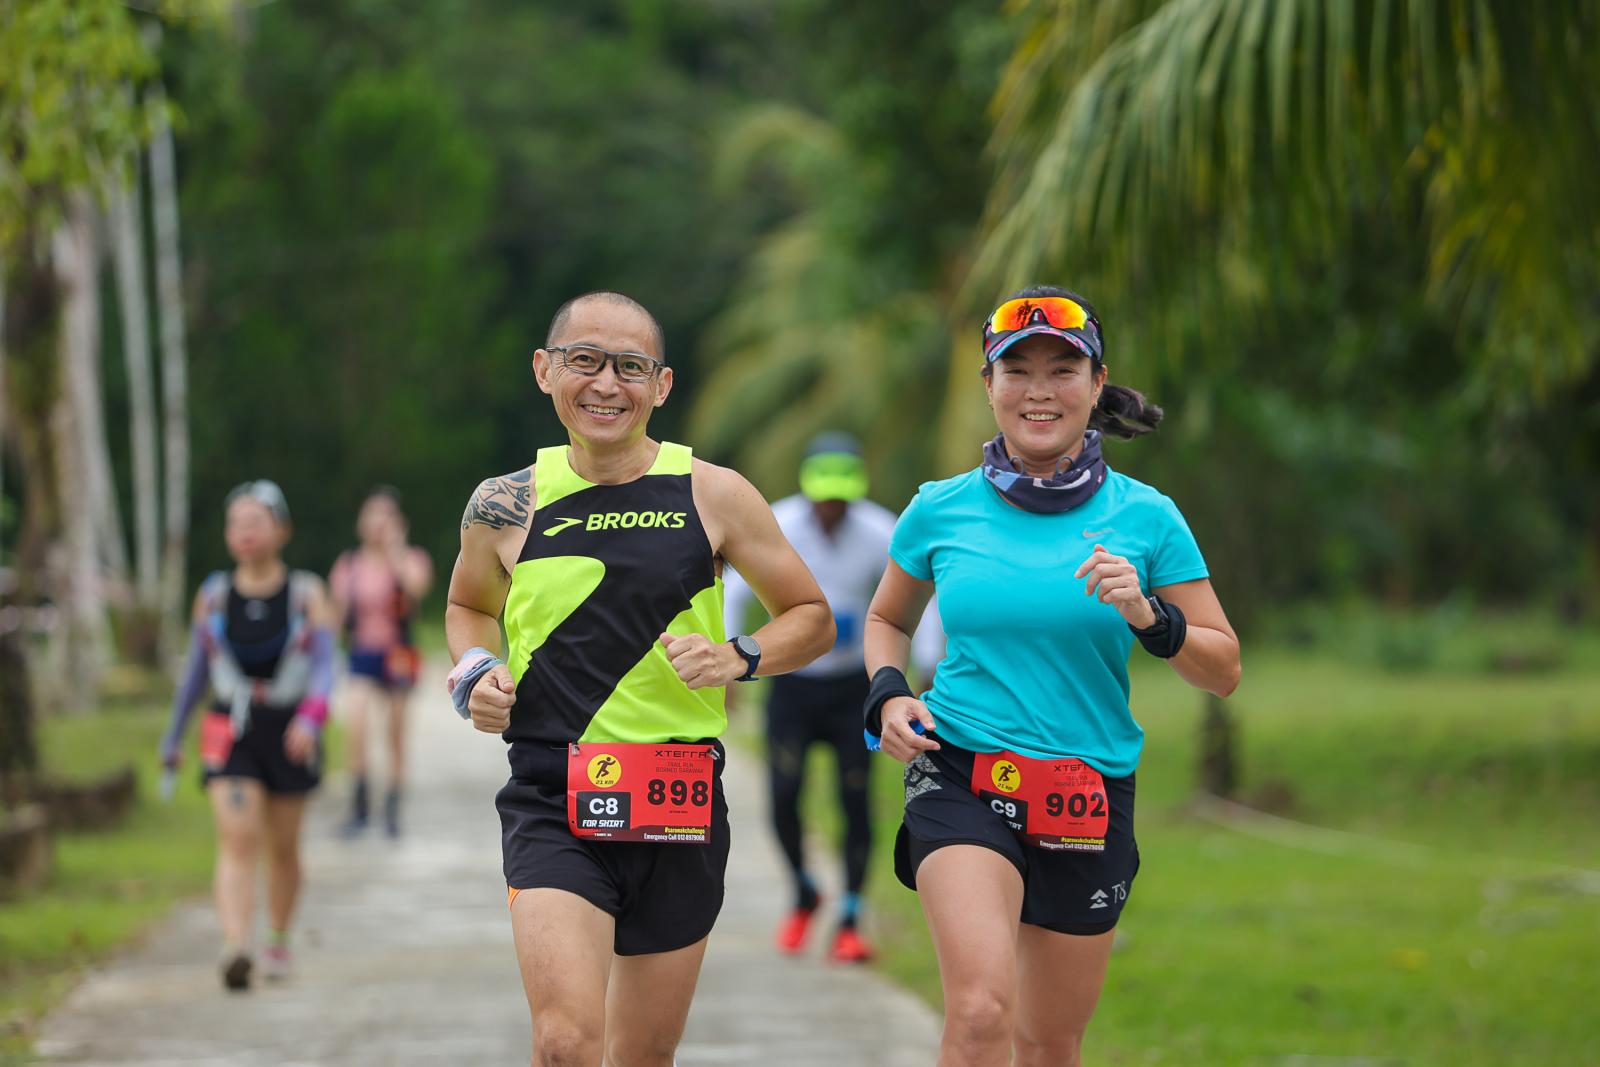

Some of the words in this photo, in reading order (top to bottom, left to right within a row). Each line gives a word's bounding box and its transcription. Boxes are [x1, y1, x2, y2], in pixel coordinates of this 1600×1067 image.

[585, 511, 688, 532] BROOKS
[655, 750, 707, 759] XTERRA
[1054, 763, 1088, 772] XTERR
[647, 779, 709, 807] 898
[589, 797, 618, 815] C8
[990, 799, 1017, 818] C9
[1045, 792, 1106, 818] 902
[582, 819, 597, 828] FOR
[598, 819, 625, 828] SHIRT
[643, 833, 667, 841] Emergency
